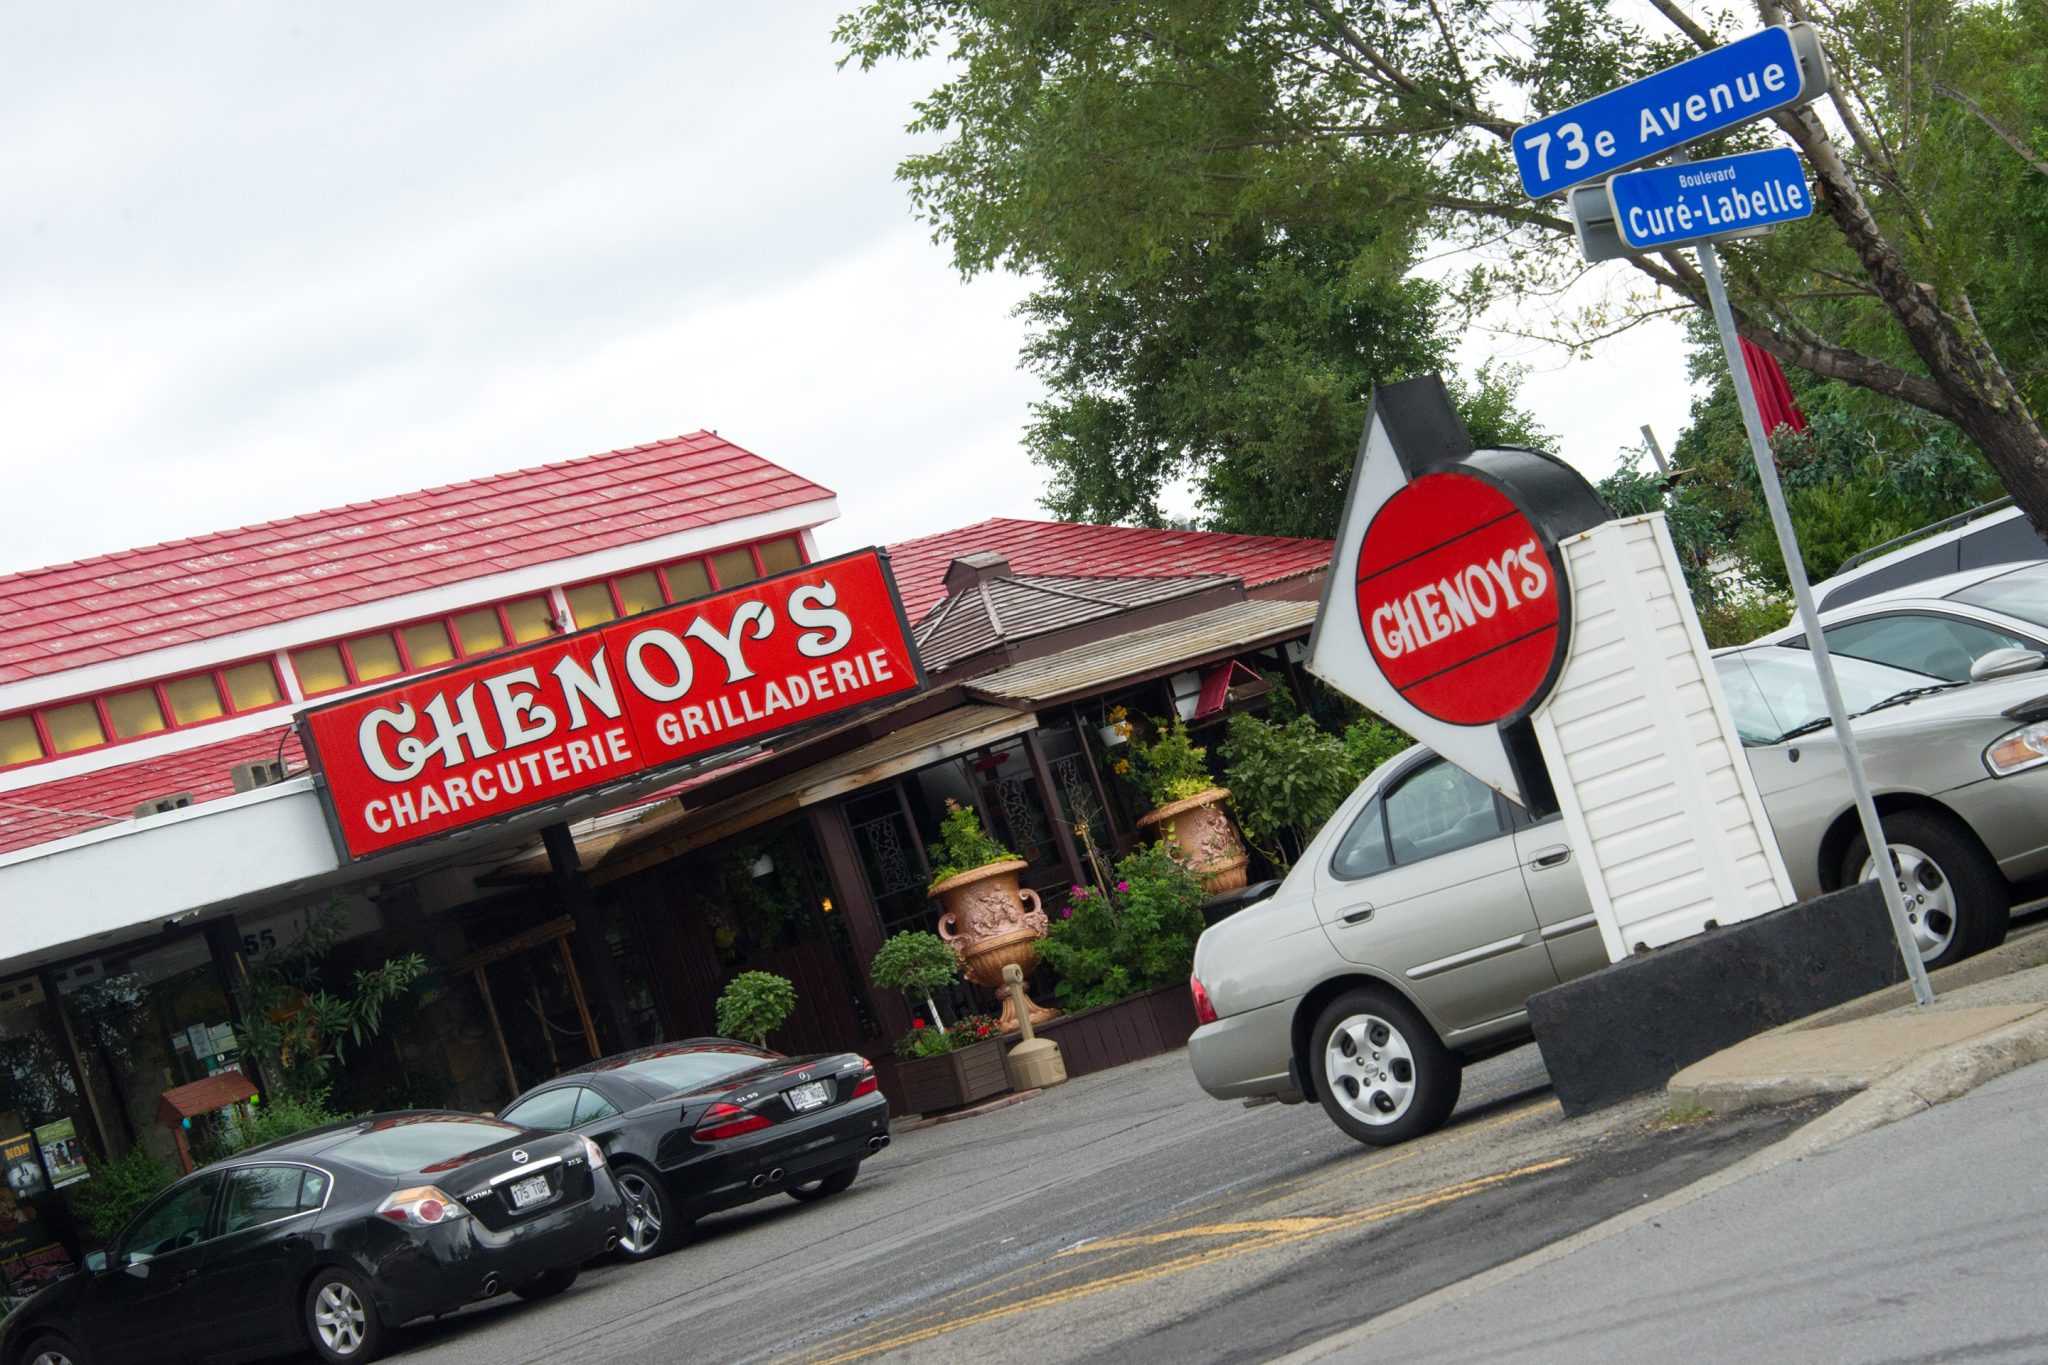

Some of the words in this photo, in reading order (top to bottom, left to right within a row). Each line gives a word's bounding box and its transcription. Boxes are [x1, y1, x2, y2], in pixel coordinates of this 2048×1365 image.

[1524, 122, 1616, 181] 73e
[1640, 63, 1786, 143] Avenue
[1679, 166, 1737, 188] Boulevard
[1629, 179, 1804, 238] Curé-Labelle
[364, 727, 633, 833] CHARCUTERIE
[656, 649, 894, 747] GRILLADERIE
[466, 1189, 493, 1203] ALTIMA
[513, 1186, 530, 1202] 175
